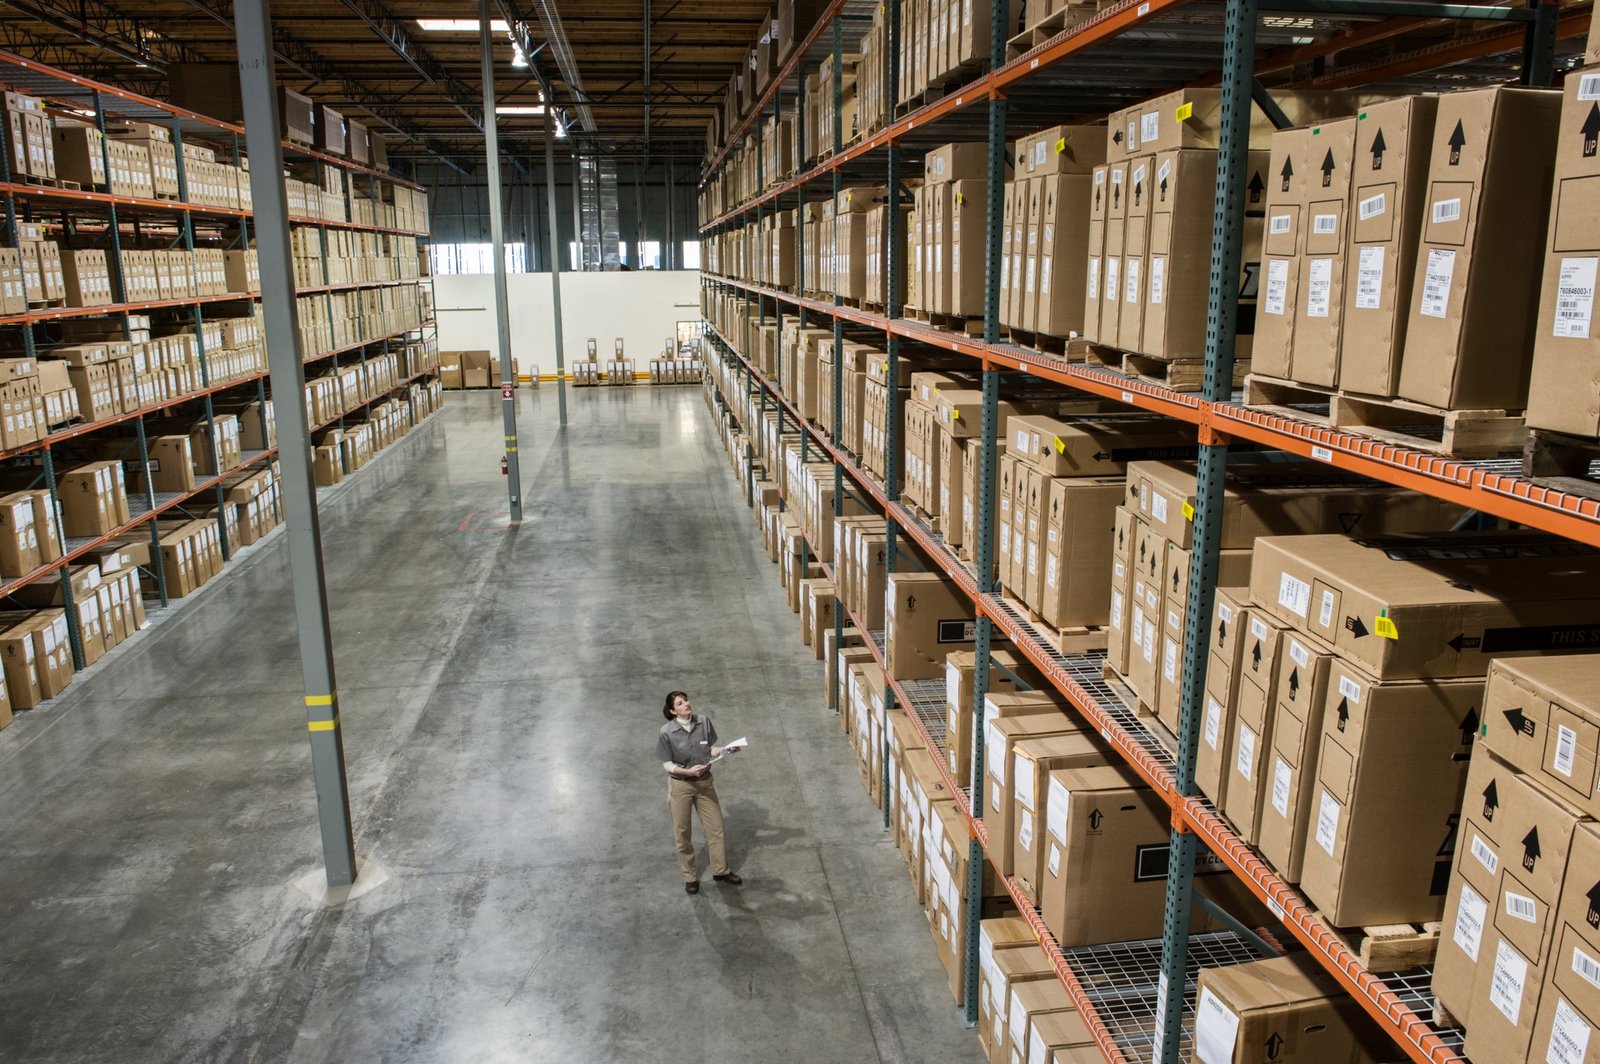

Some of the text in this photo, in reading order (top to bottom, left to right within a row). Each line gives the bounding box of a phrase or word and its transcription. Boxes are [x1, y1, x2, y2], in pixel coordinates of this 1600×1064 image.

[1585, 140, 1596, 154] UP
[1373, 156, 1382, 169] UP
[1450, 151, 1459, 163] UP
[1551, 630, 1585, 644] THIS
[1523, 720, 1534, 735] UP
[1484, 805, 1493, 817] UP
[1524, 855, 1534, 869] UP
[1588, 908, 1600, 925] UP
